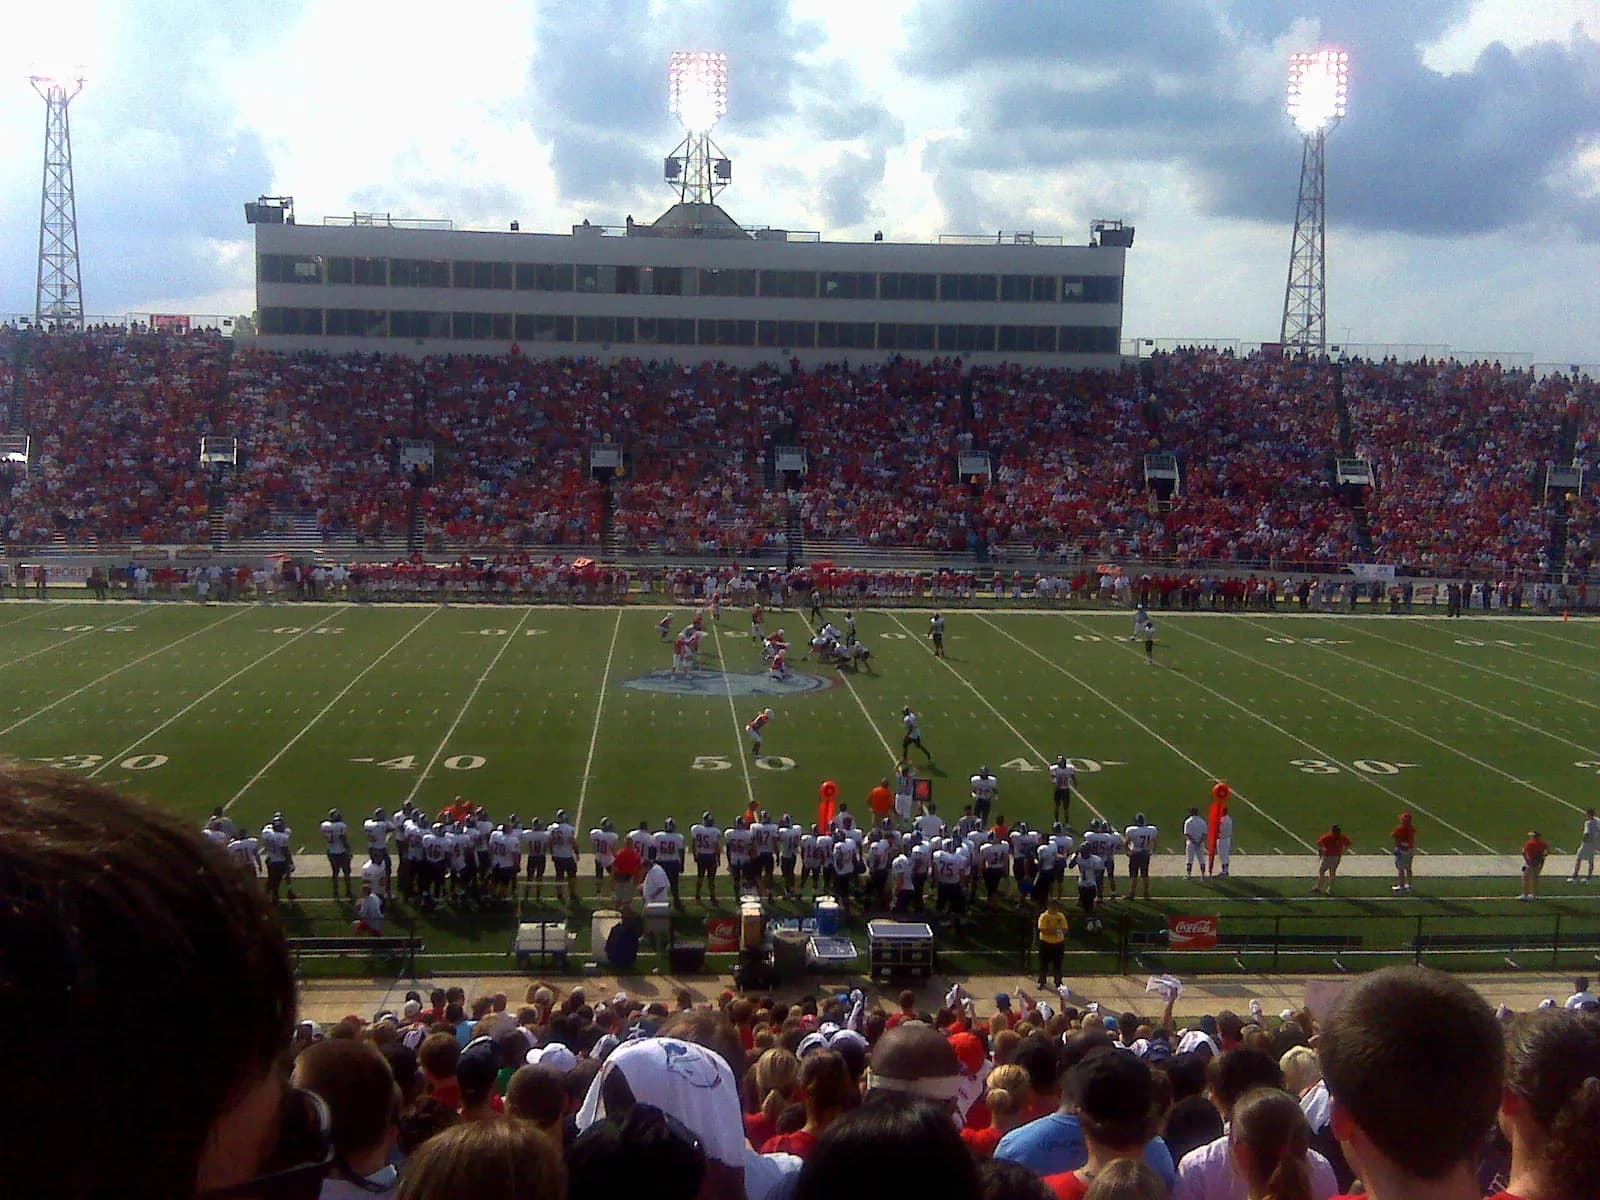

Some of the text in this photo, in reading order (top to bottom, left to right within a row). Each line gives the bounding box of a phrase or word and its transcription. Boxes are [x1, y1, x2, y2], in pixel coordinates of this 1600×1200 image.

[50, 567, 90, 577] SPORTS
[50, 754, 168, 769] 30
[376, 754, 487, 770] 40
[691, 755, 796, 771] 50
[1000, 757, 1102, 773] 40
[1289, 759, 1400, 775] 30
